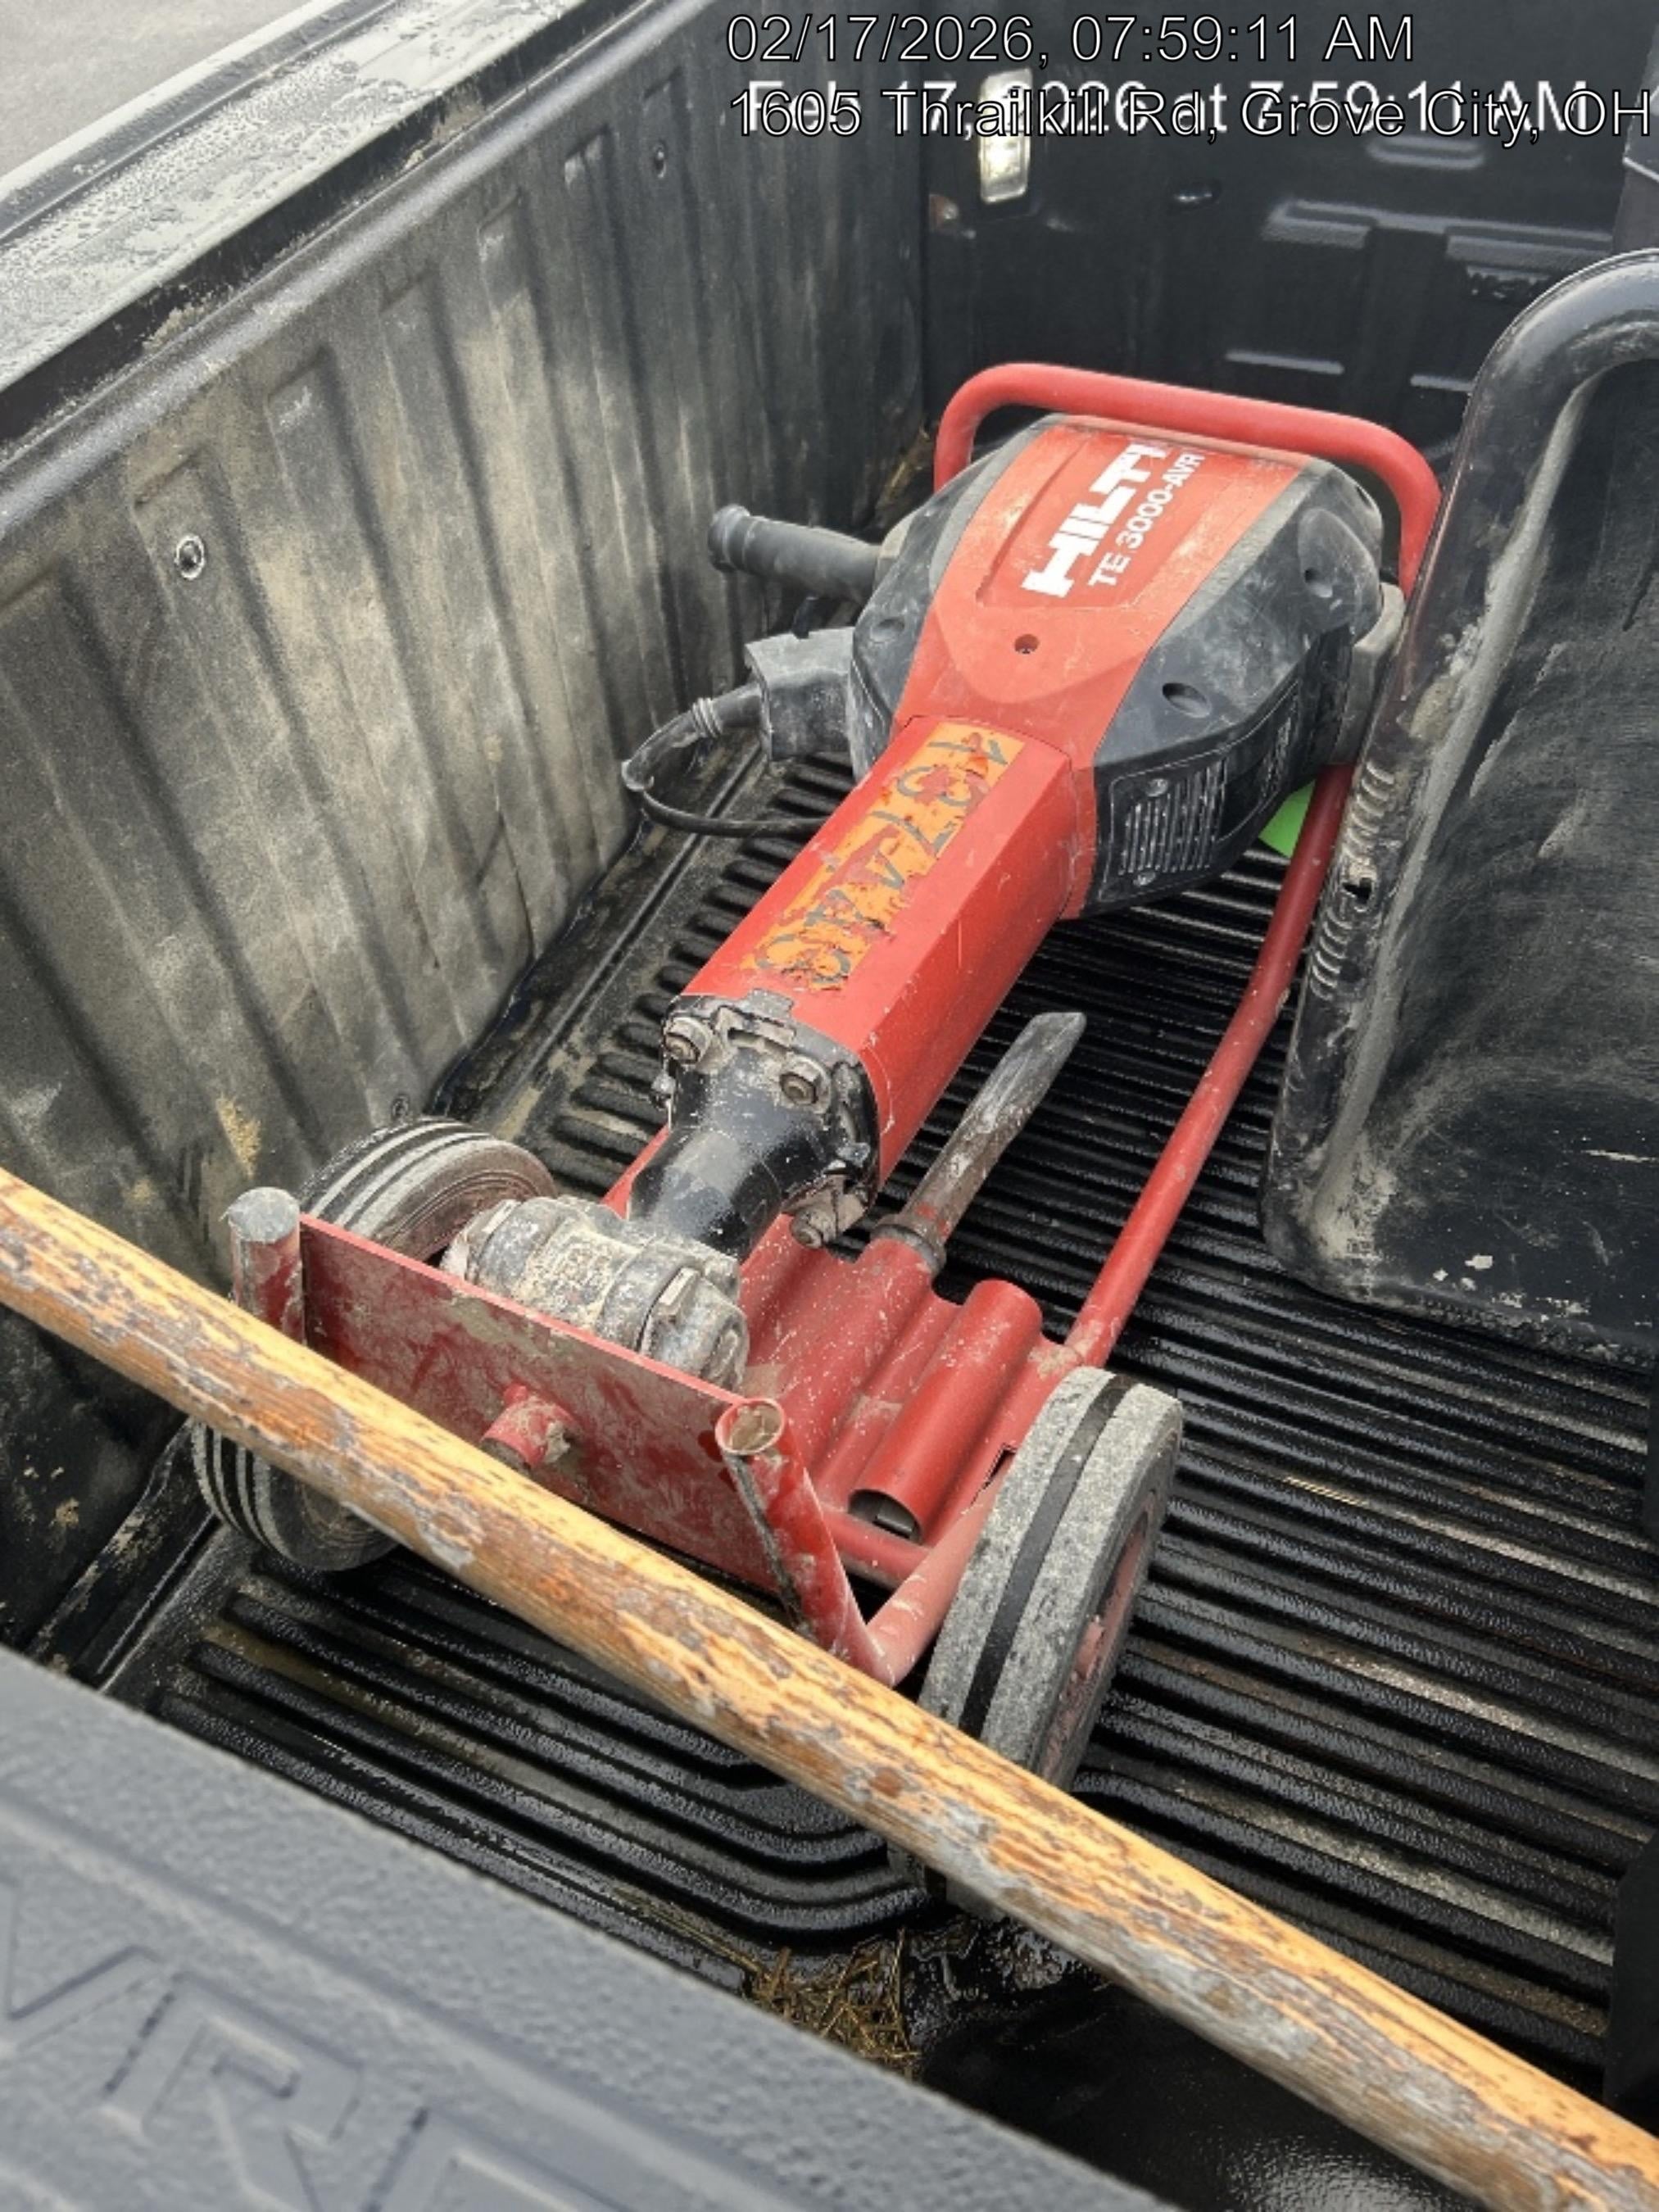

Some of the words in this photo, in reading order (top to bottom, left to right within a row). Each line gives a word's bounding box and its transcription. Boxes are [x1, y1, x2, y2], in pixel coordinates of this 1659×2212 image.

[1021, 442, 1167, 598] HILTI
[1088, 551, 1131, 587] TE
[1114, 451, 1206, 551] 3000-AVR
